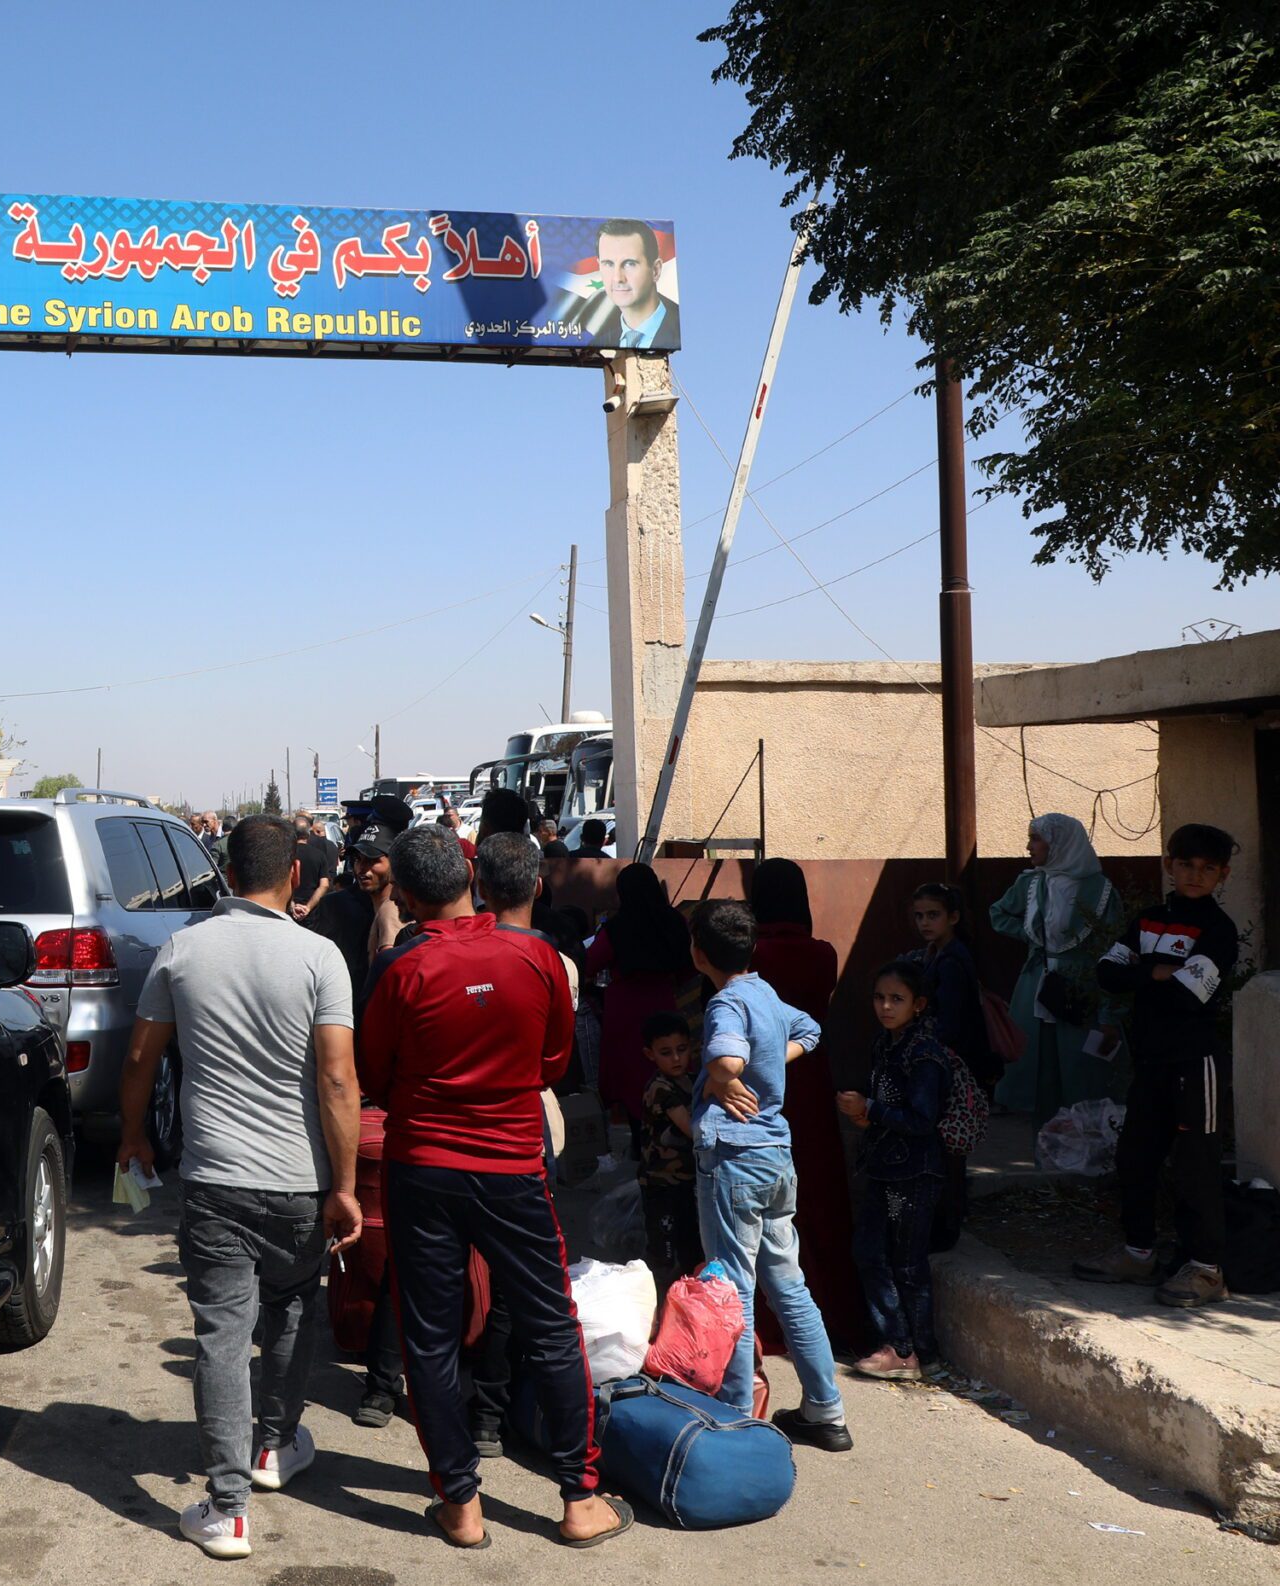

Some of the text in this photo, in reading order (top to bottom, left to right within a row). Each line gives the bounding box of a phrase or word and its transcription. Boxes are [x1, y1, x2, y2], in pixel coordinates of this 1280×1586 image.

[8, 202, 256, 284] الجمهورية
[269, 215, 321, 297] في
[333, 222, 432, 291] بكم
[266, 307, 422, 339] Republic
[464, 319, 511, 337] الحدودي
[512, 319, 556, 338] المركز
[40, 993, 61, 1003] V8
